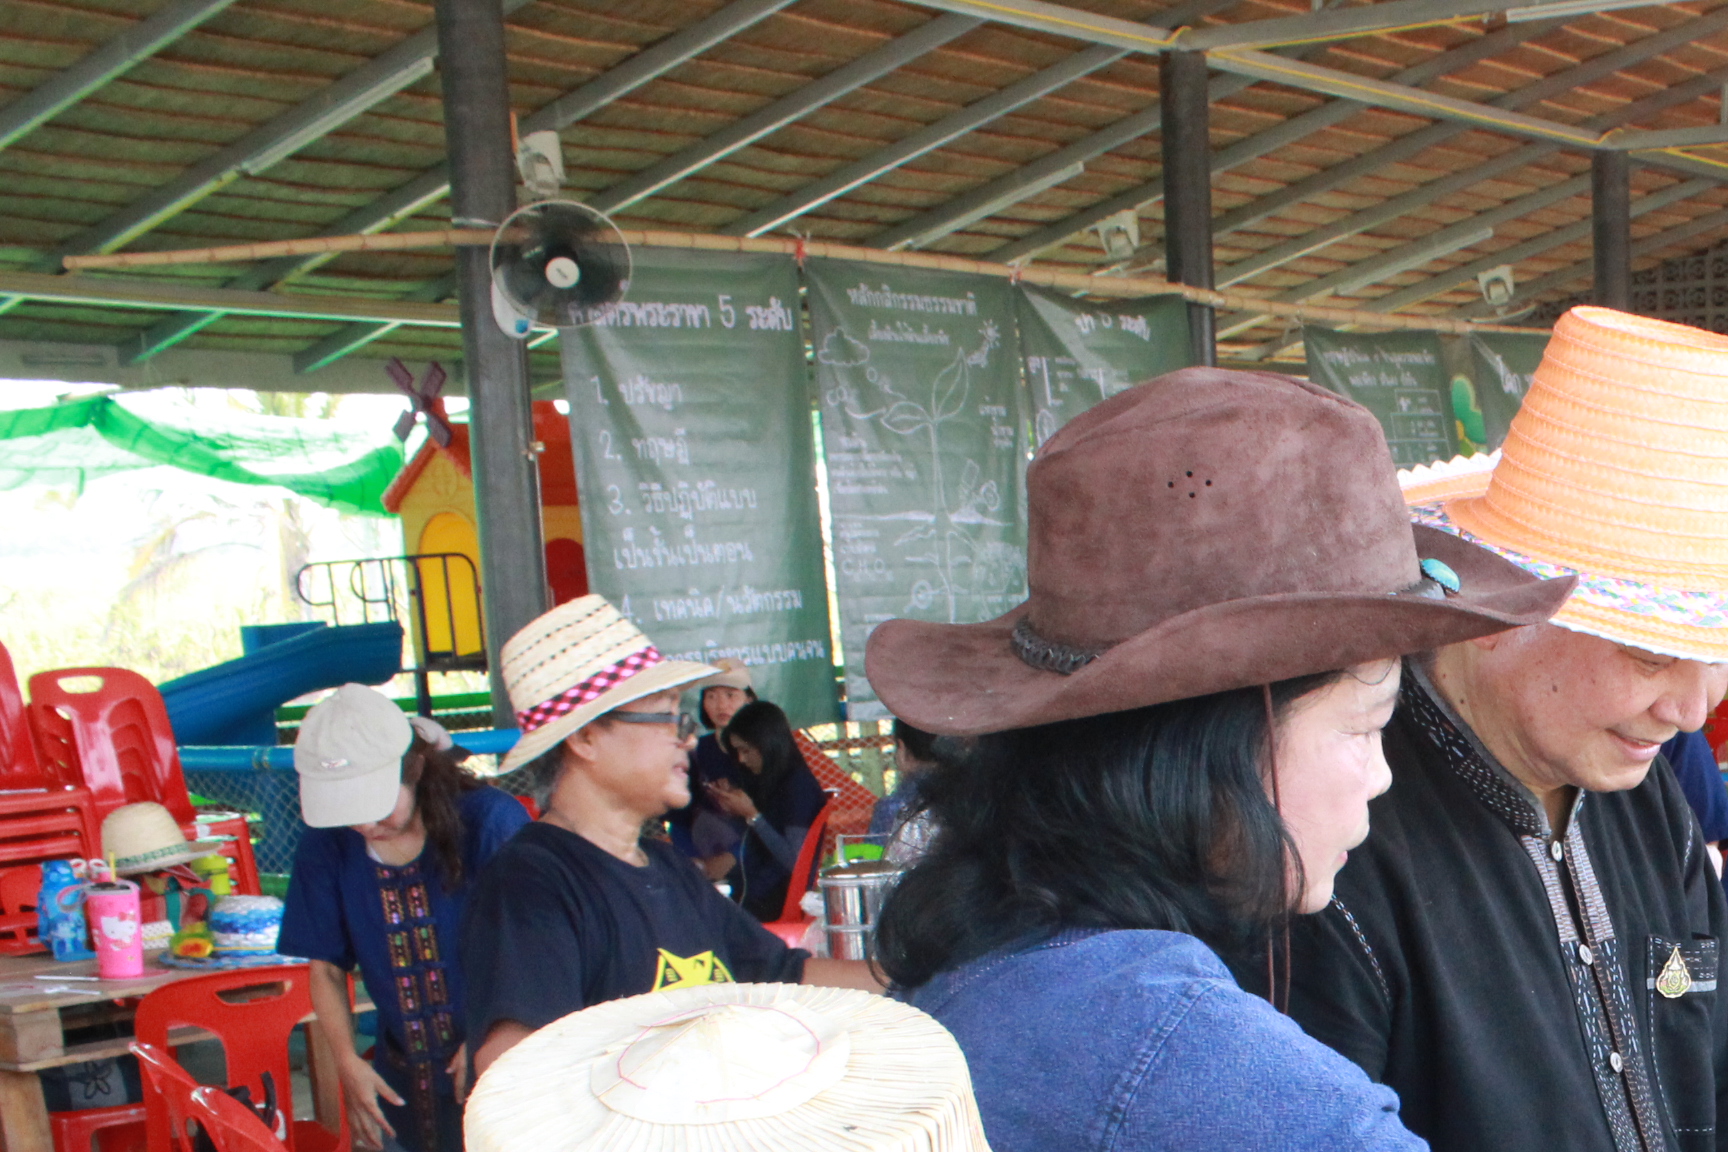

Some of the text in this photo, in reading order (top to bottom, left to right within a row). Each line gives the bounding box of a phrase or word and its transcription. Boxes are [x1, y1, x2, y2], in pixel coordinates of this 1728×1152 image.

[718, 295, 736, 329] 5
[745, 296, 794, 331] ระดับ
[590, 375, 610, 405] 1.
[600, 427, 691, 466] 2. ทฤษฎี
[607, 484, 632, 516] 3.
[613, 524, 755, 570] เป็นขั้นเป็นตอน
[620, 594, 644, 624] 4.
